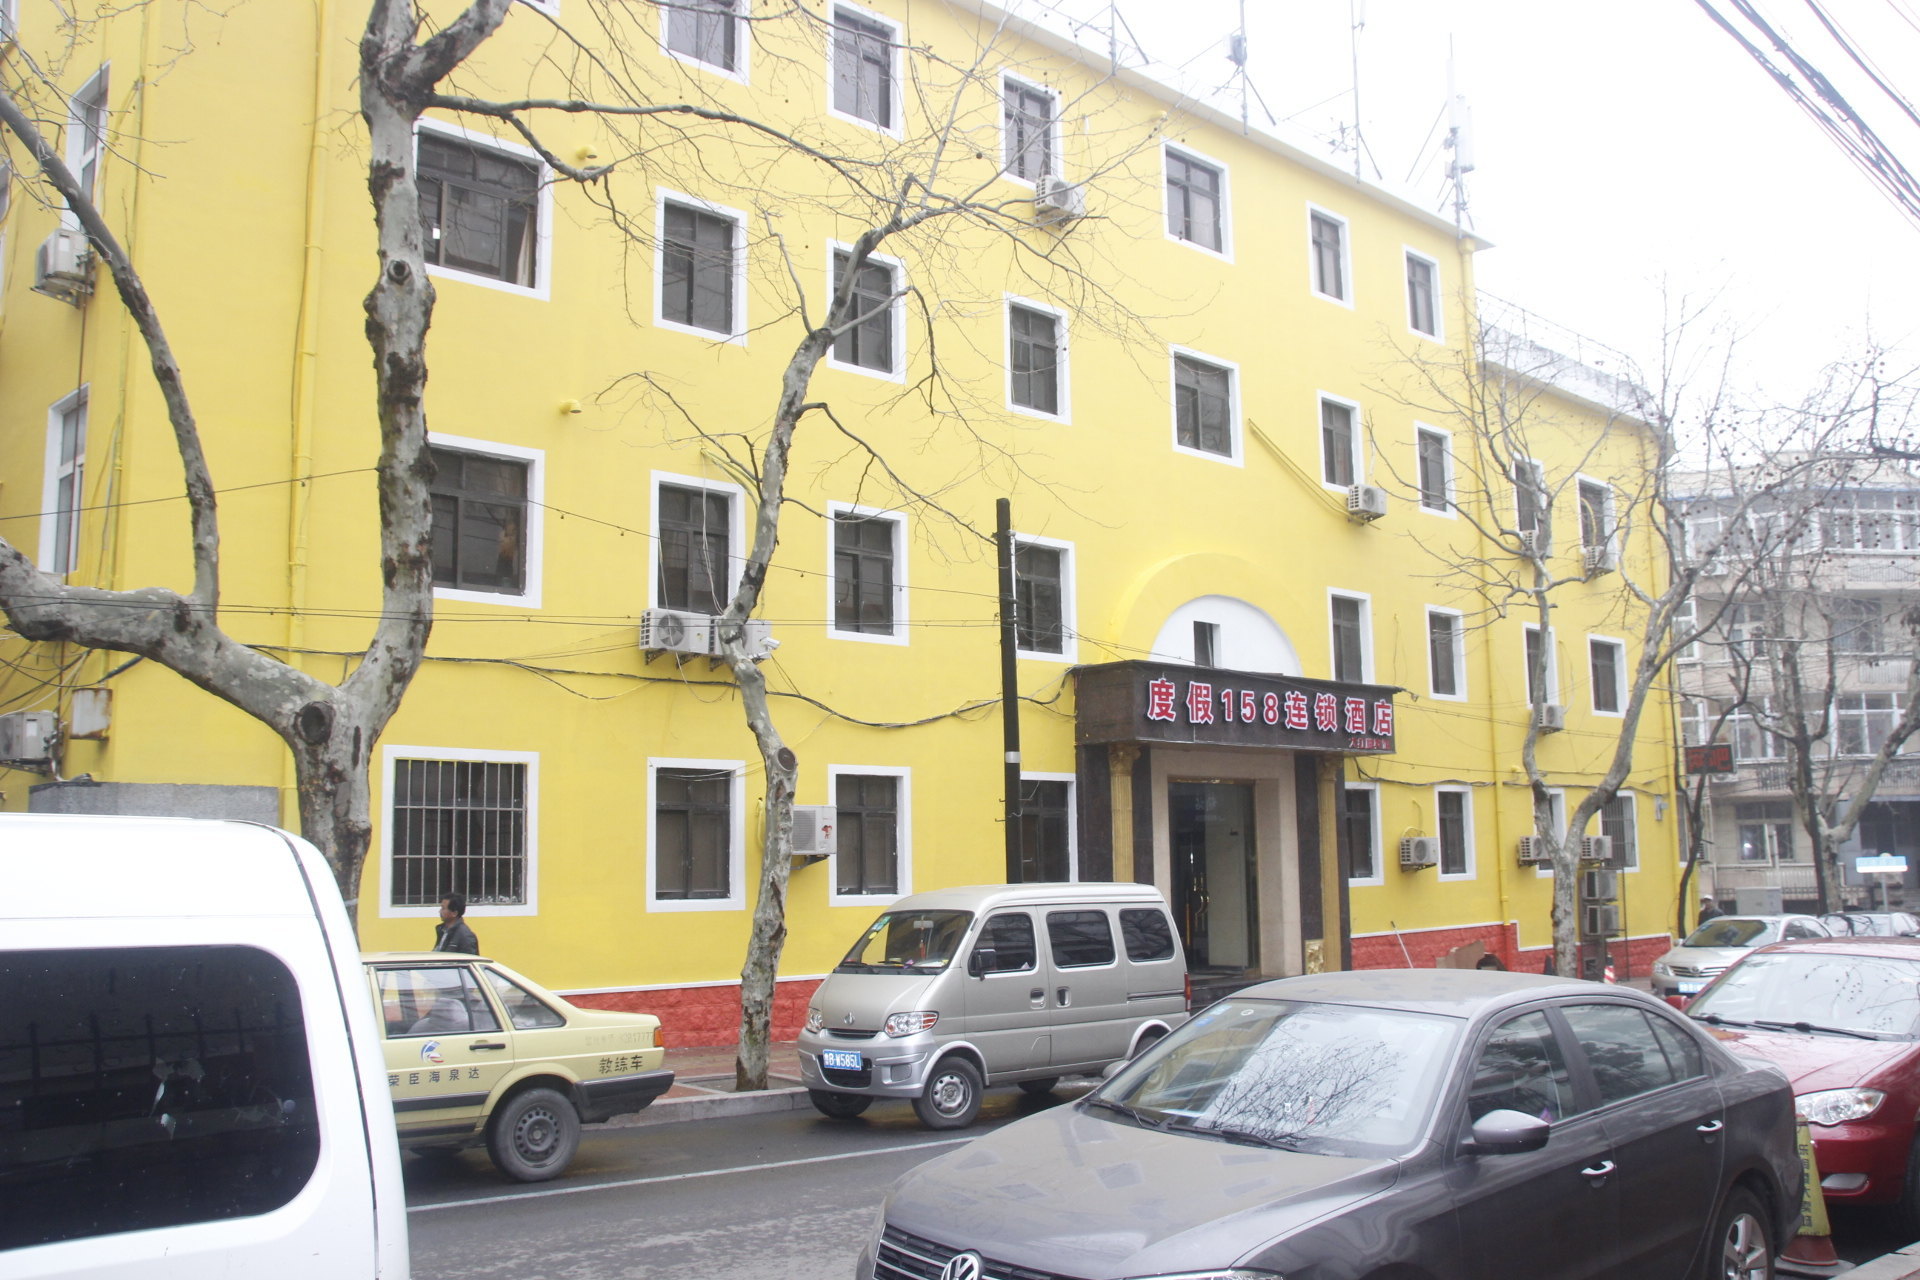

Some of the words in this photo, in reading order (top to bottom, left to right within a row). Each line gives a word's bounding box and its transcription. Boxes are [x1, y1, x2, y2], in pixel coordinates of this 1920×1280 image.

[1147, 679, 1393, 736] 度假158连锁酒店
[599, 1055, 643, 1074] 教练车
